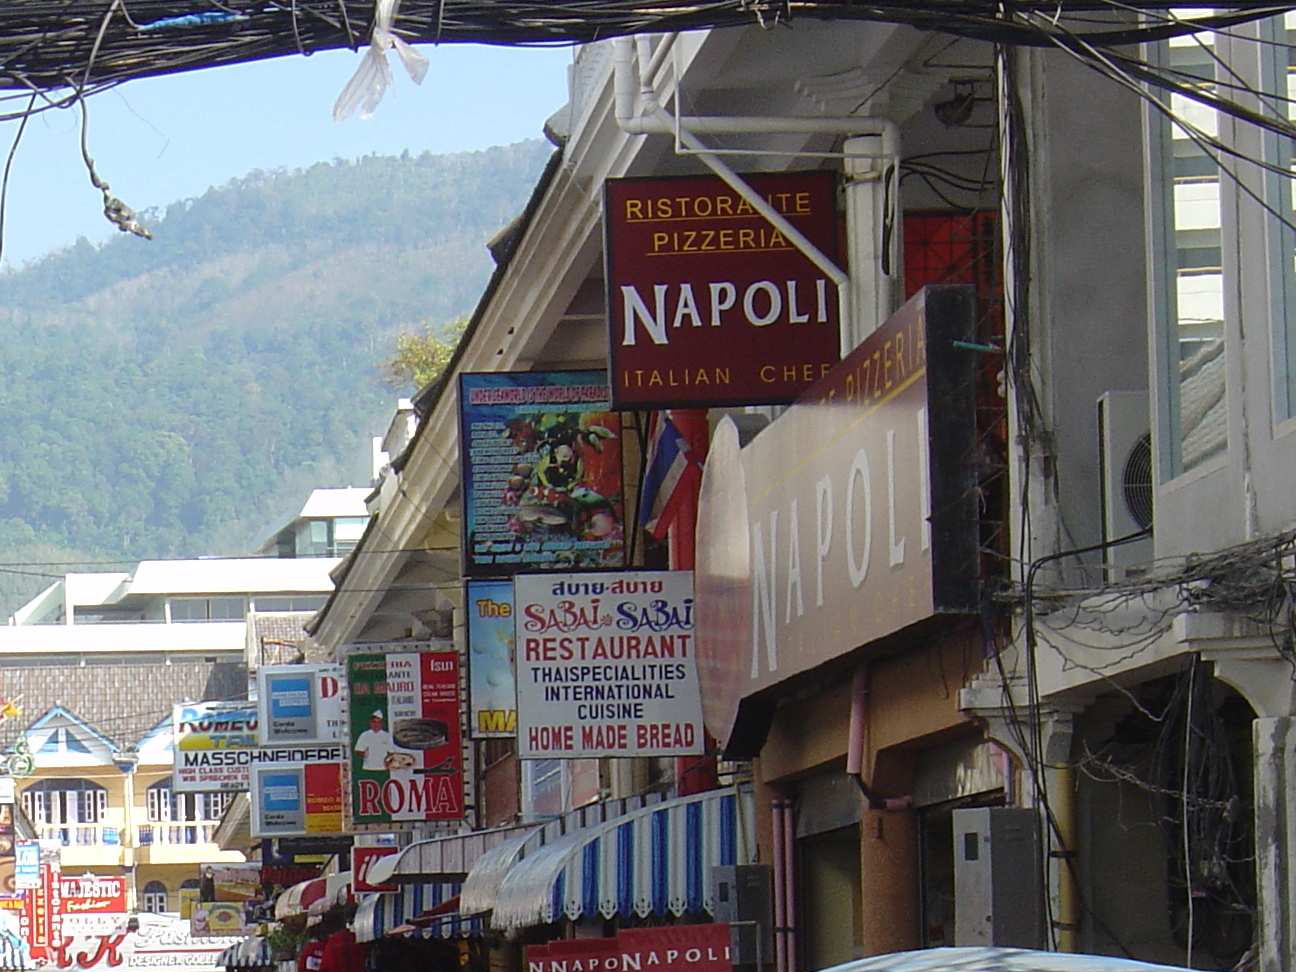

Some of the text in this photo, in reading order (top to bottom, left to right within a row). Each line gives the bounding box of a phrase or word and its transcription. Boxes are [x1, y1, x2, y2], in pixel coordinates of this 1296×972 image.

[625, 193, 810, 220] RISTORATE
[654, 229, 786, 252] PIZZERIA
[621, 279, 827, 346] NAPOLI
[625, 367, 730, 387] ITALIAN
[750, 407, 931, 679] NAPOLI
[476, 600, 512, 618] The
[525, 634, 692, 662] RESTAURANT
[545, 684, 675, 701] INTERNATIONAL
[179, 707, 259, 733] ROMEO
[577, 703, 644, 721] CUISINE
[529, 723, 695, 751] HOME MADE BREAD
[359, 777, 459, 815] ROMA
[60, 880, 121, 898] MAJESTIC
[622, 946, 730, 971] NAPOLI
